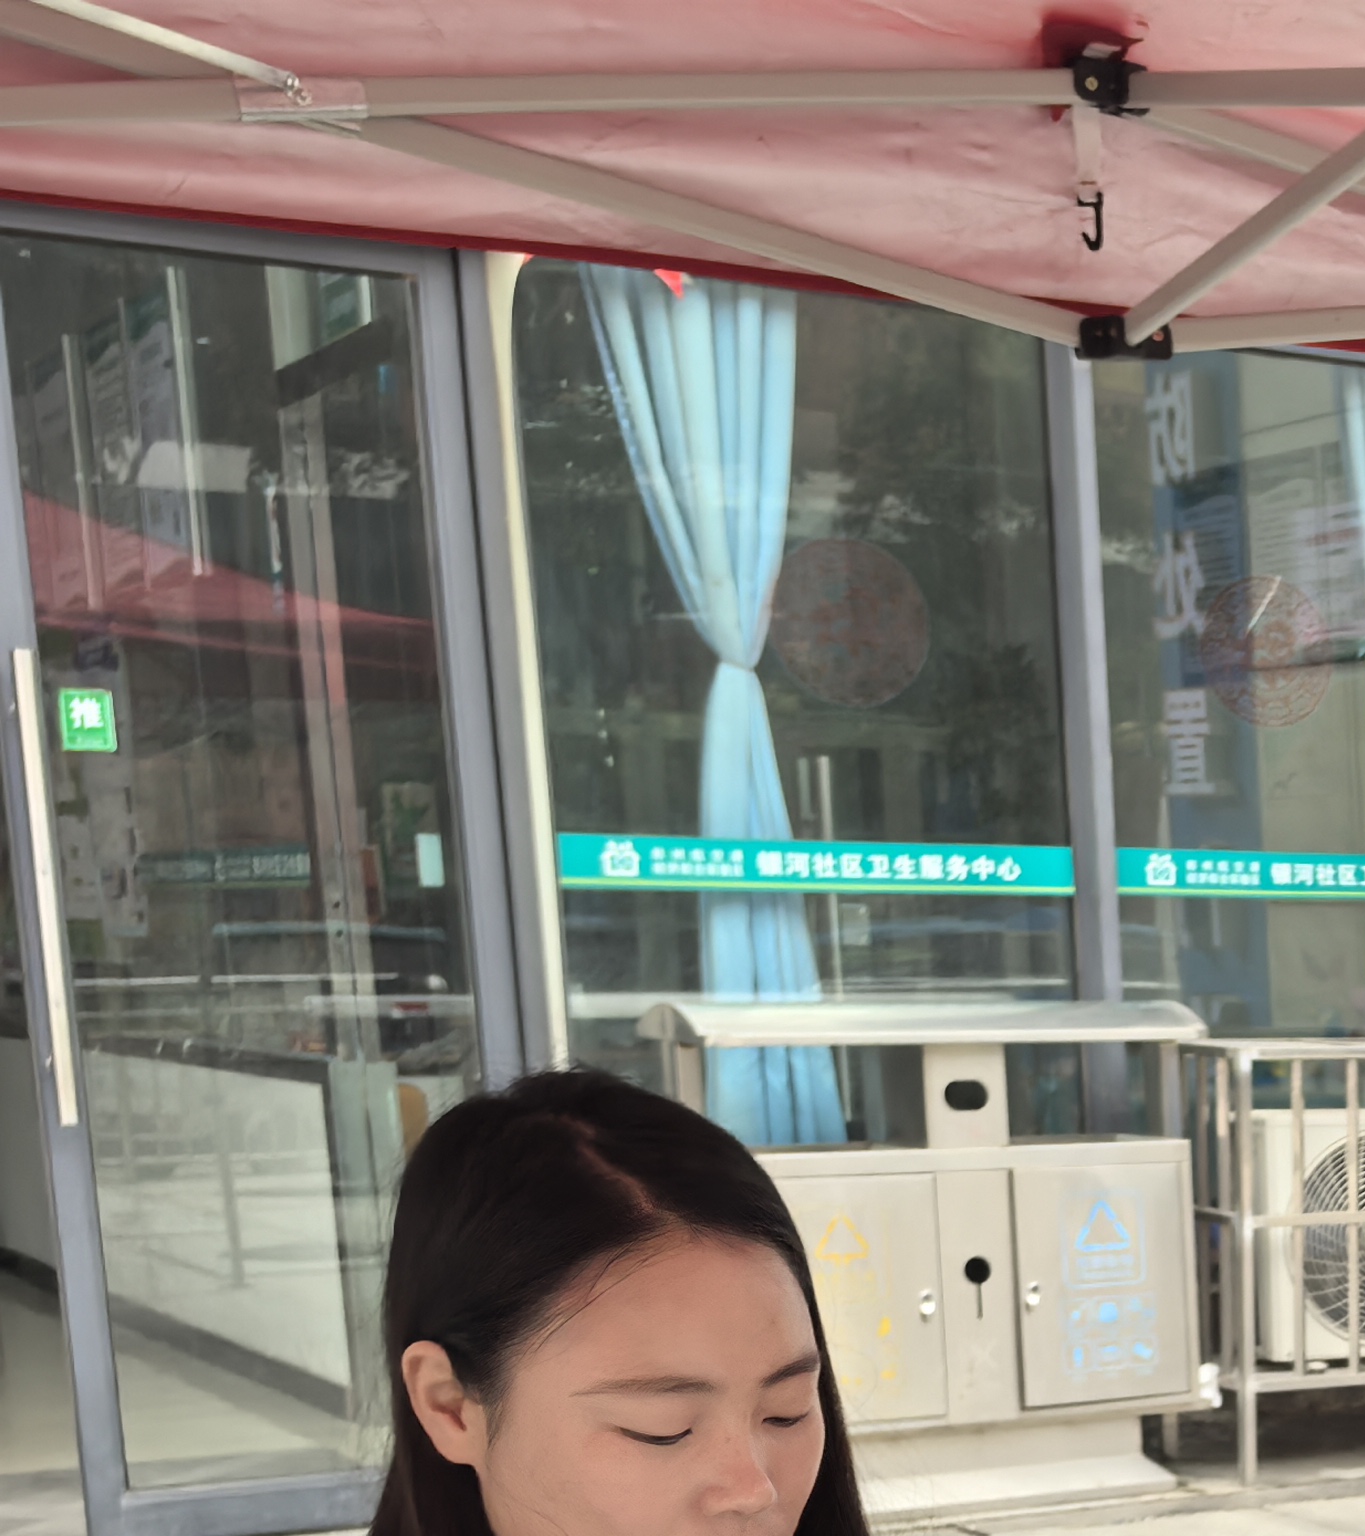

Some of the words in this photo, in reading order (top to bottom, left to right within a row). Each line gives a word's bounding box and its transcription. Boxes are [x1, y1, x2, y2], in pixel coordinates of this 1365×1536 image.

[69, 697, 105, 730] 推
[755, 849, 1023, 883] 银河社区卫生服务中心
